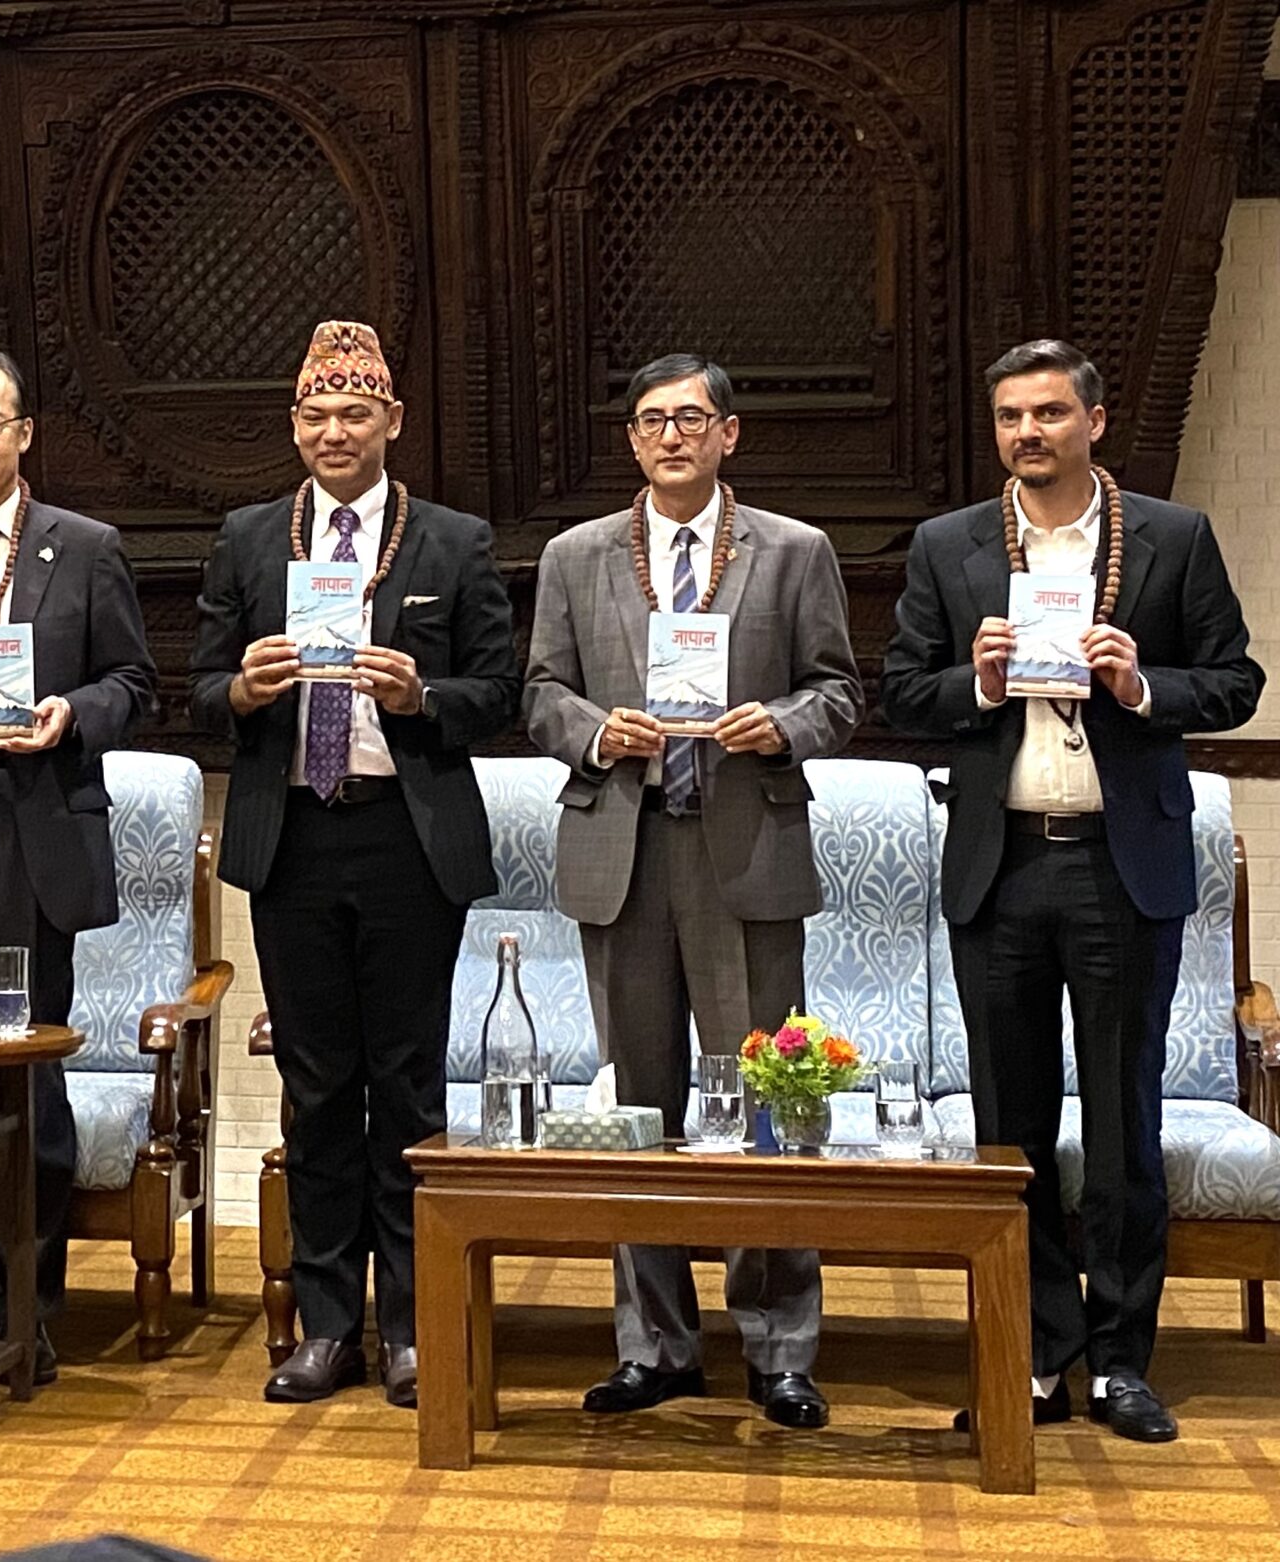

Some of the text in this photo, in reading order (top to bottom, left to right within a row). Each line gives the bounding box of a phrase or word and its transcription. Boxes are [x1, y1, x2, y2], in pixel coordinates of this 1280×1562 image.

[311, 577, 354, 592] जापान
[1033, 590, 1082, 608] जापान
[672, 630, 717, 646] जापान
